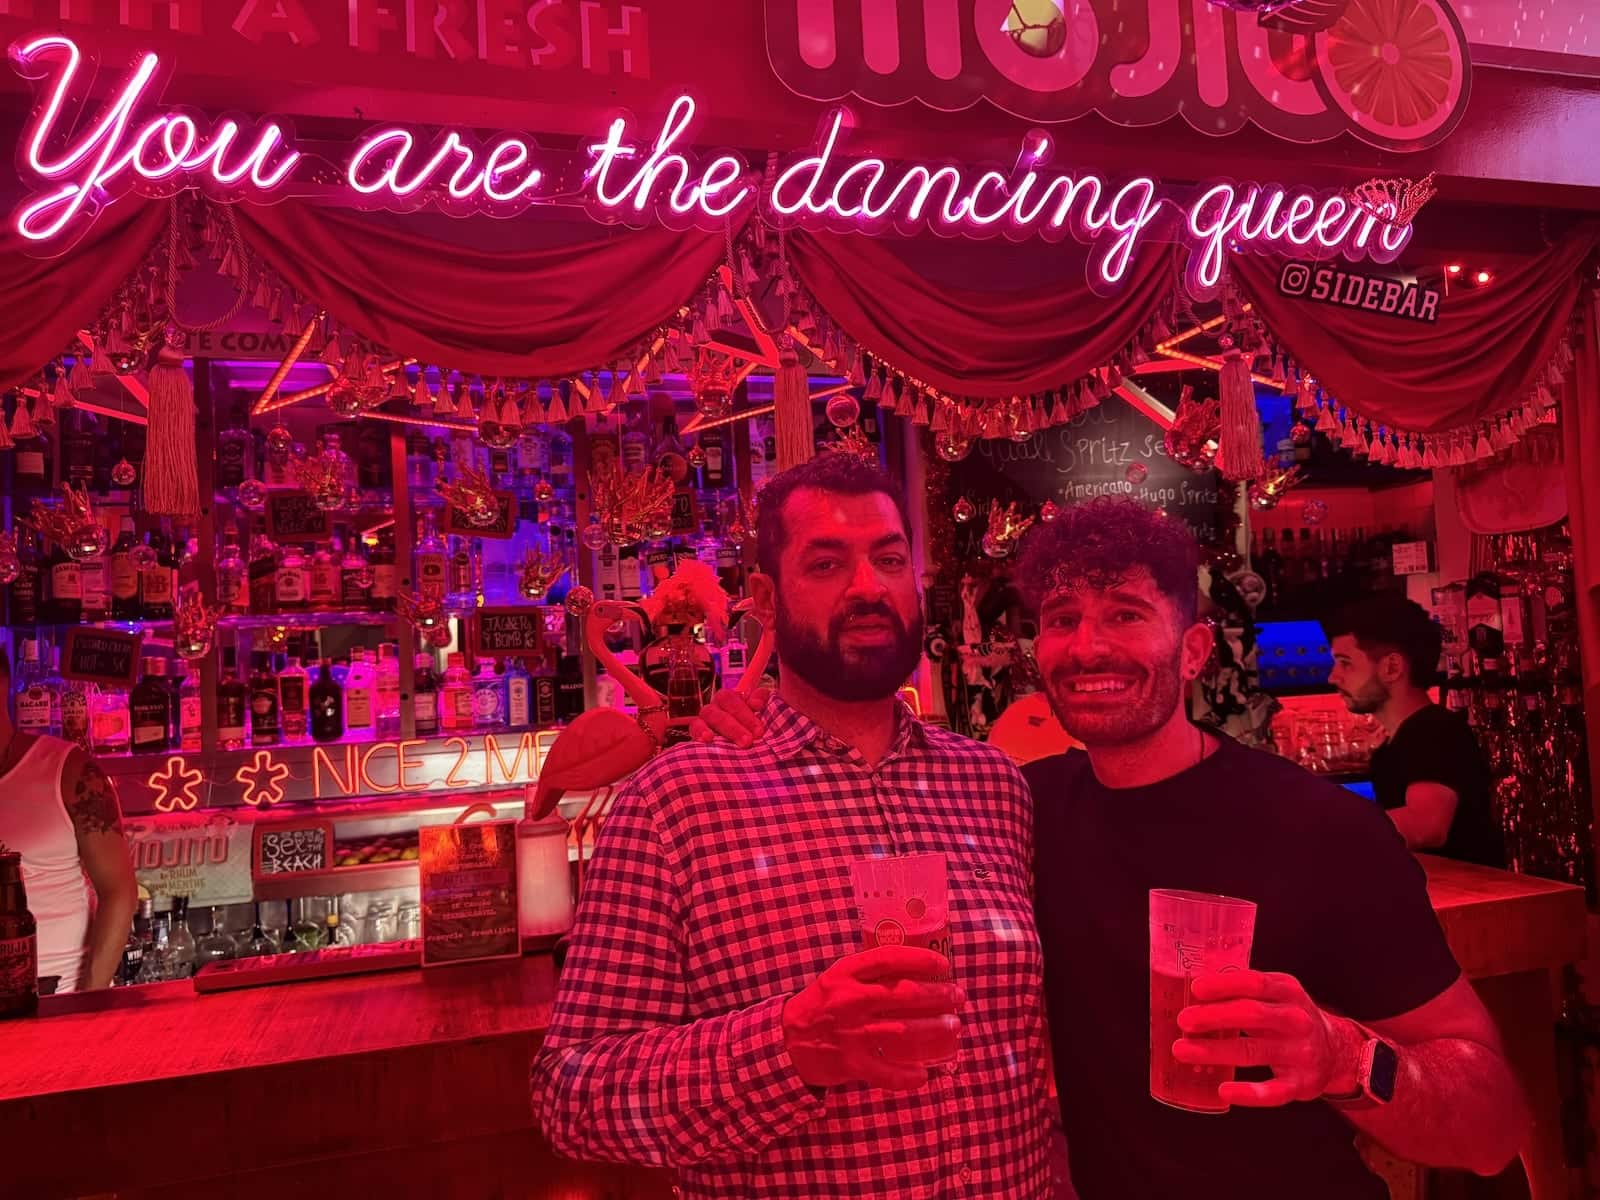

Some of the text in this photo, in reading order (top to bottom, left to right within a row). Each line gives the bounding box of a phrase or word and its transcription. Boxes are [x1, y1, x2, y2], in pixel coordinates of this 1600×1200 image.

[12, 36, 1412, 287] You are the dancing queen
[1311, 270, 1439, 321] SIDEBAR
[1064, 480, 1133, 499] Americano
[1139, 486, 1176, 508] Hugo
[312, 741, 430, 798] NICE
[444, 737, 469, 787] 2
[271, 853, 323, 875] BEACH
